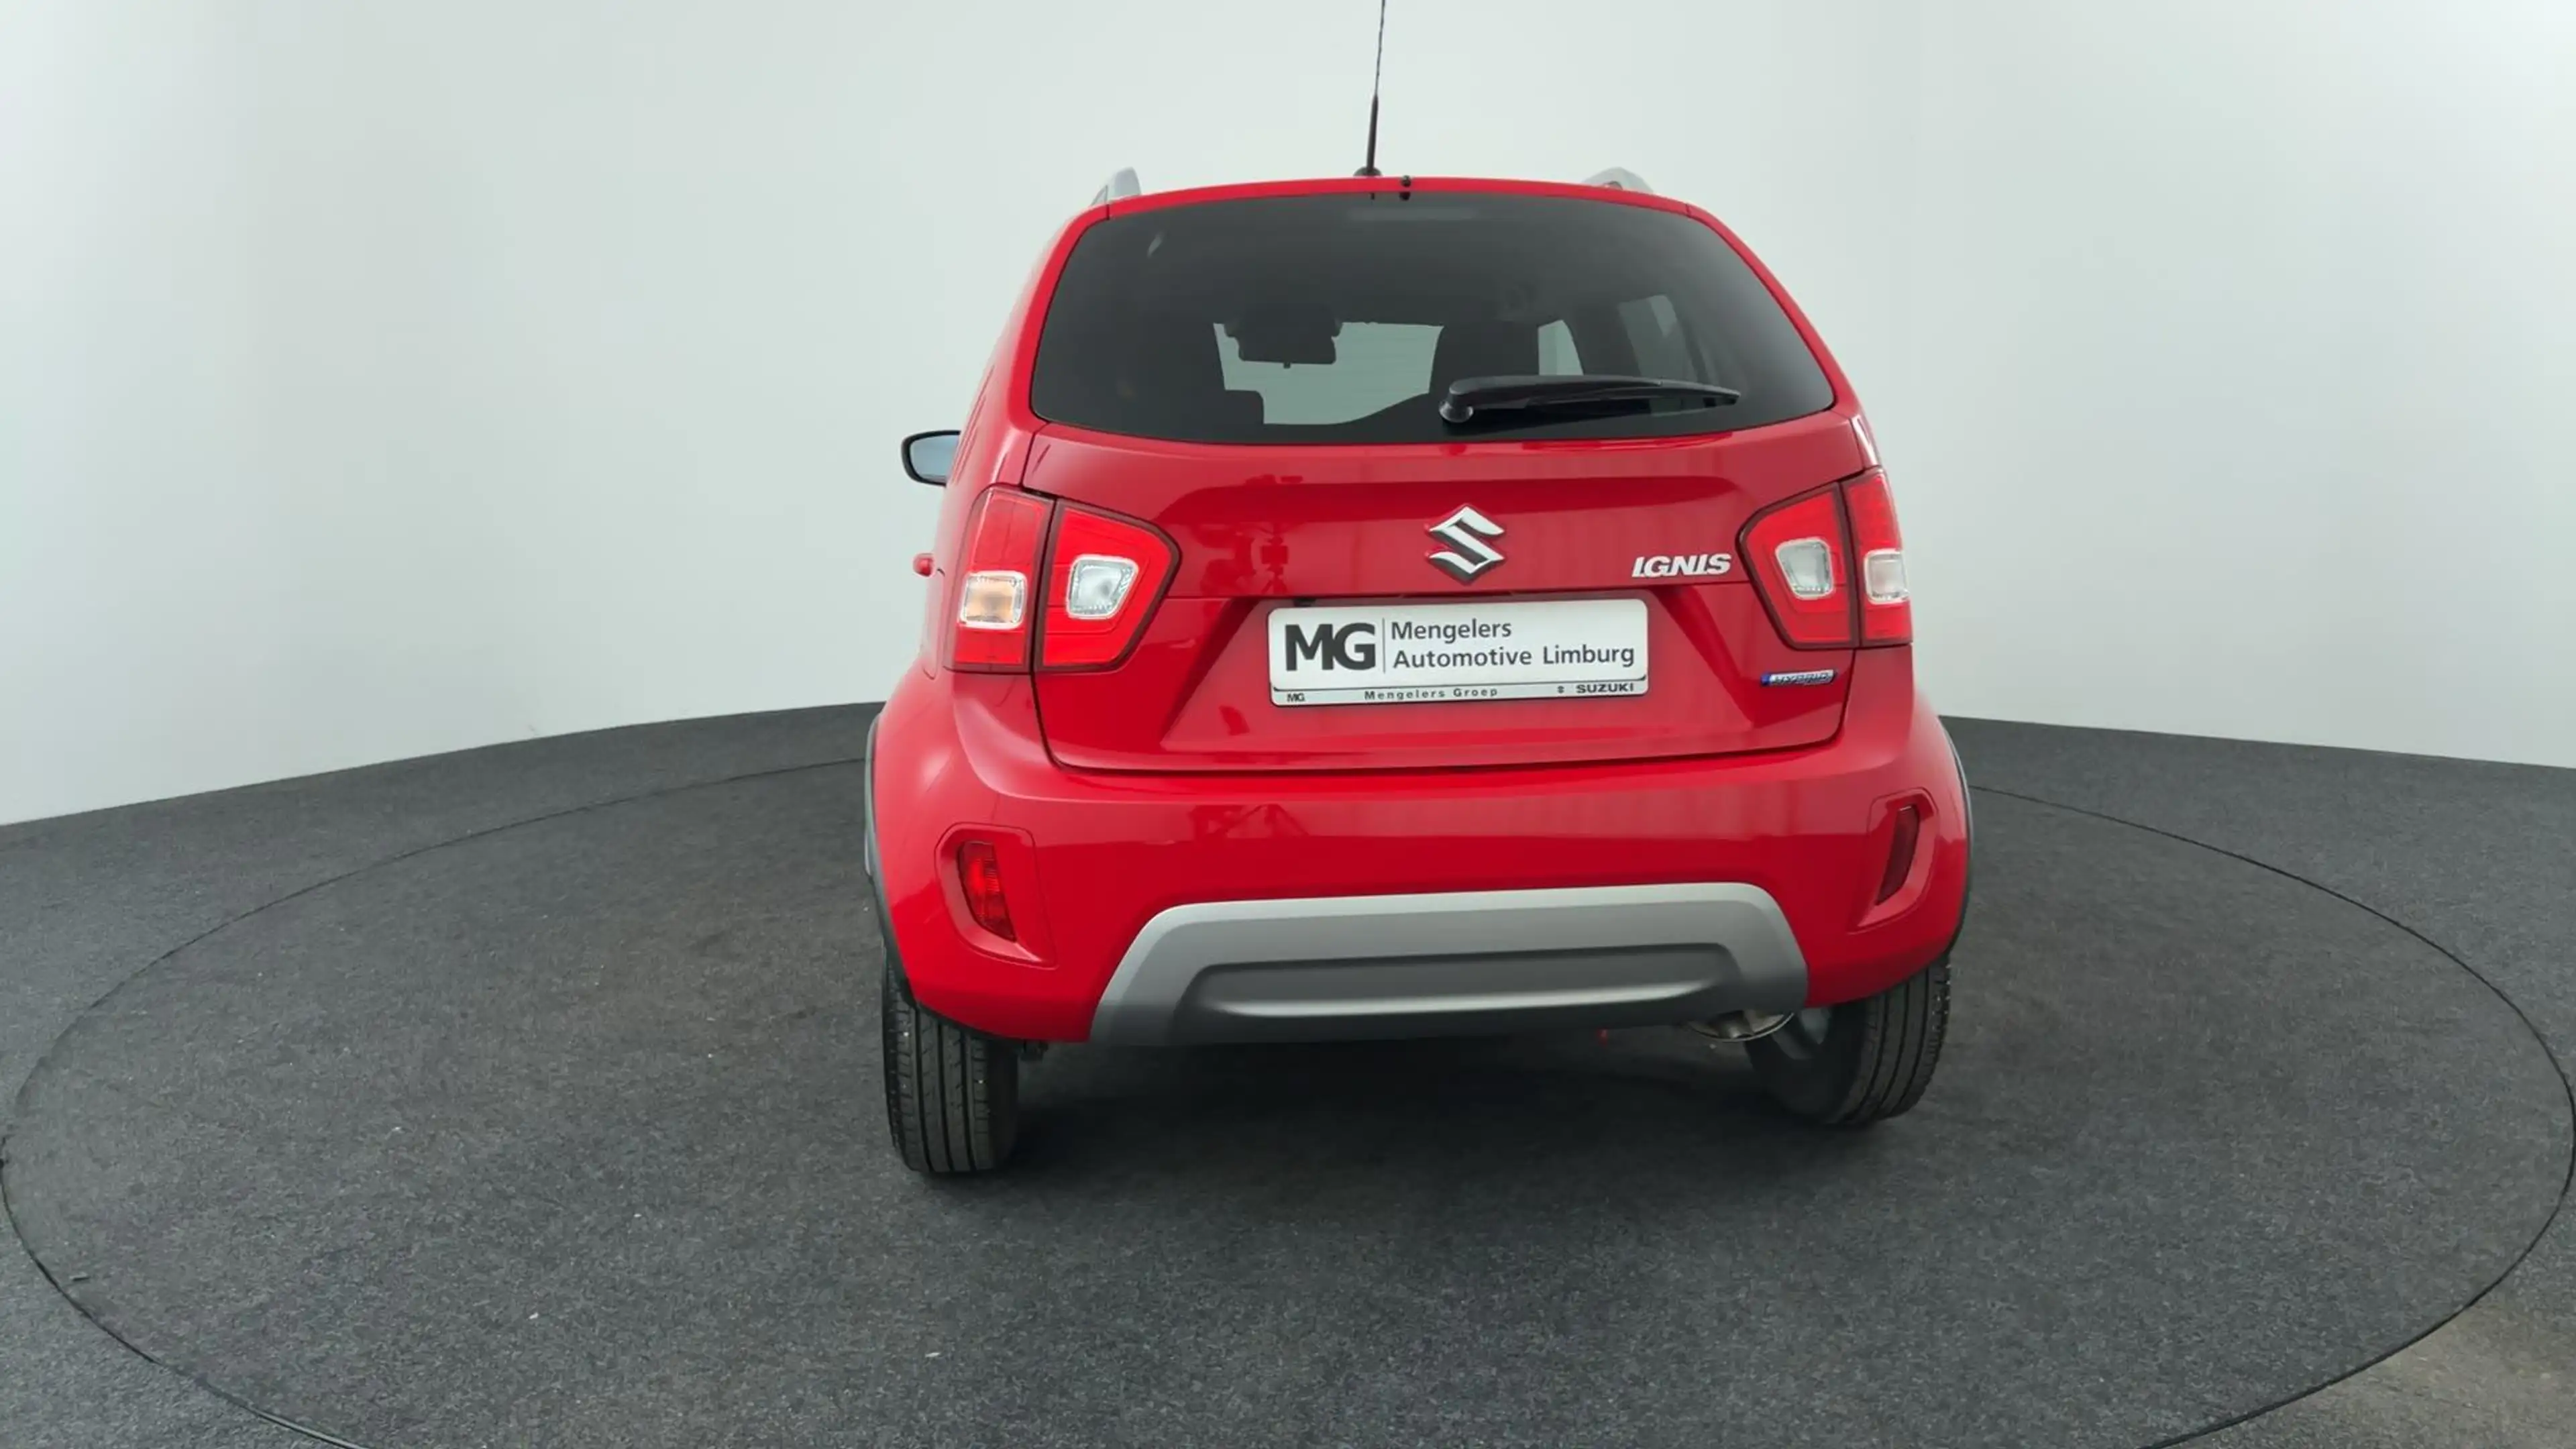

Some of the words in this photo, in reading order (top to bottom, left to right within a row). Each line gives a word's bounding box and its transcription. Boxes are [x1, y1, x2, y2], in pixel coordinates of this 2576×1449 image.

[1631, 553, 1731, 578] IGNIS
[1391, 619, 1512, 644] Mengelers
[1285, 622, 1377, 672] MG
[1393, 646, 1532, 669] Automotive
[1543, 643, 1635, 668] Limburg
[1287, 693, 1305, 702] MG
[1364, 689, 1446, 700] Mengelers
[1453, 687, 1498, 697] Groep
[1576, 683, 1634, 694] SUZUKI
